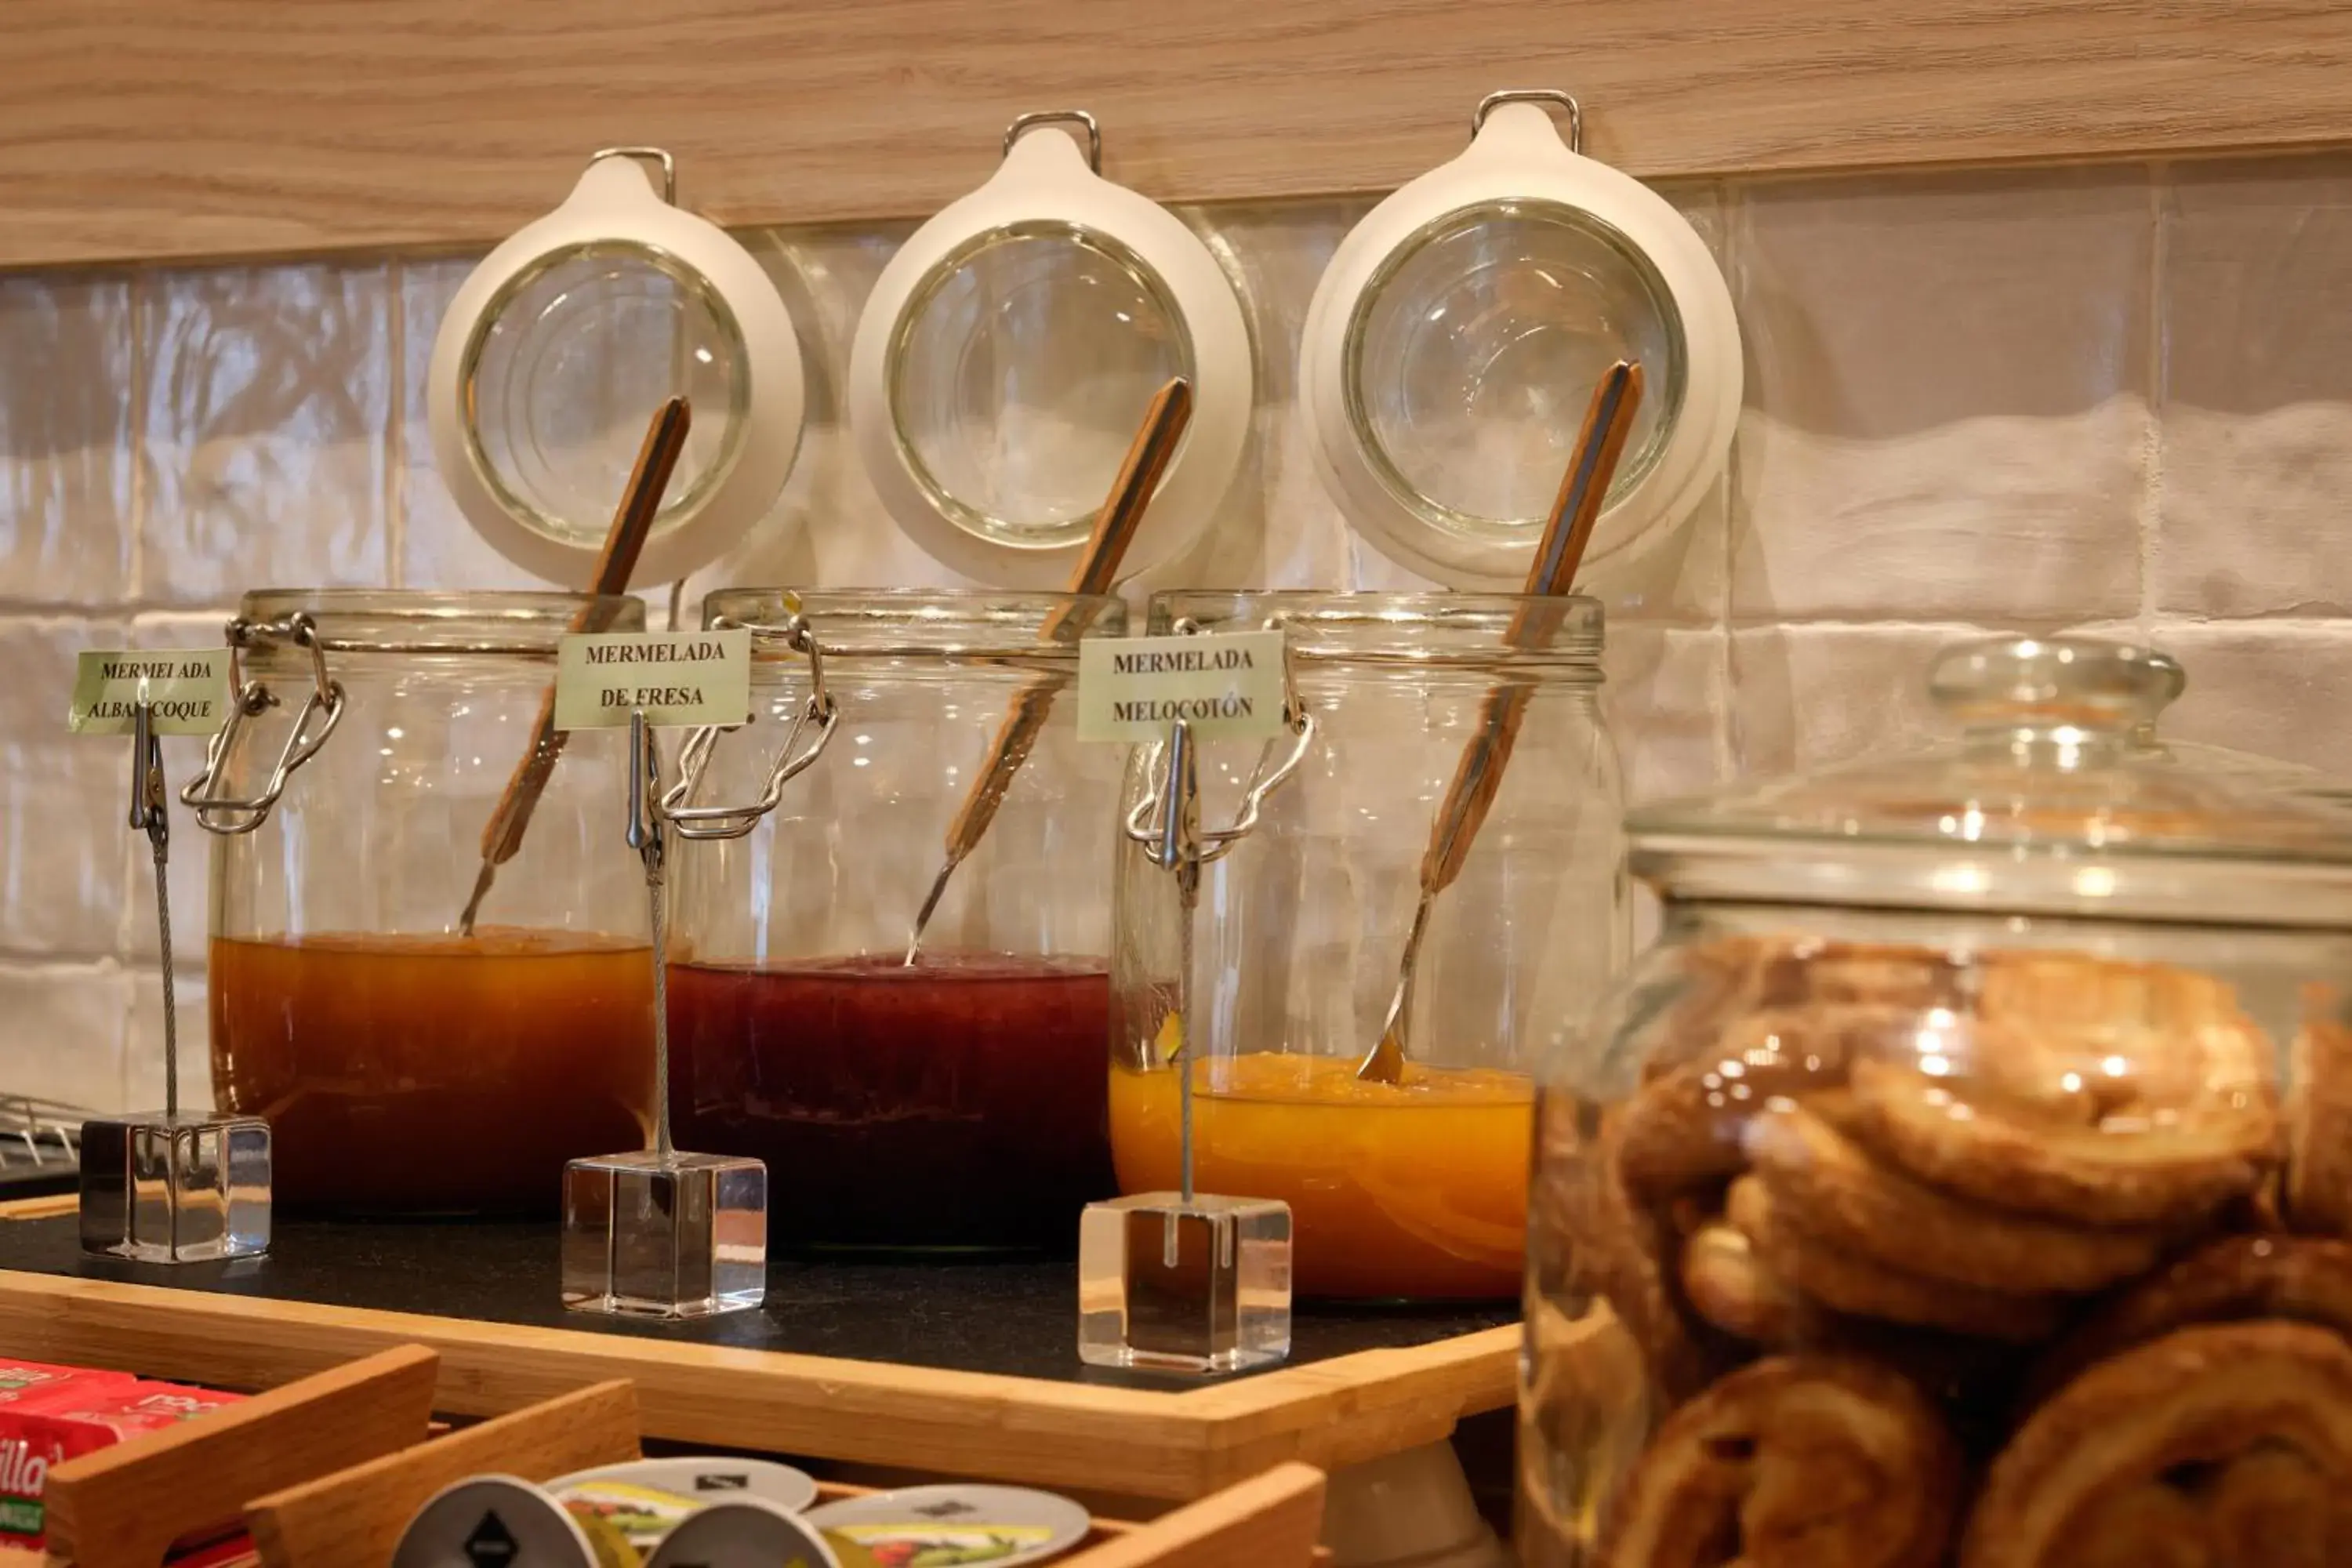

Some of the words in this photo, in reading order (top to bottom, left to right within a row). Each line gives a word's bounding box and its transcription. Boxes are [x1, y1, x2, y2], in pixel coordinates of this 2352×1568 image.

[586, 641, 725, 664] MERMELADA
[1114, 649, 1254, 674] MERMELADA
[601, 688, 628, 707] DE
[635, 687, 704, 706] FRESA
[1114, 691, 1254, 721] MELOCOTÓN
[88, 700, 211, 720] ALBACOQUE
